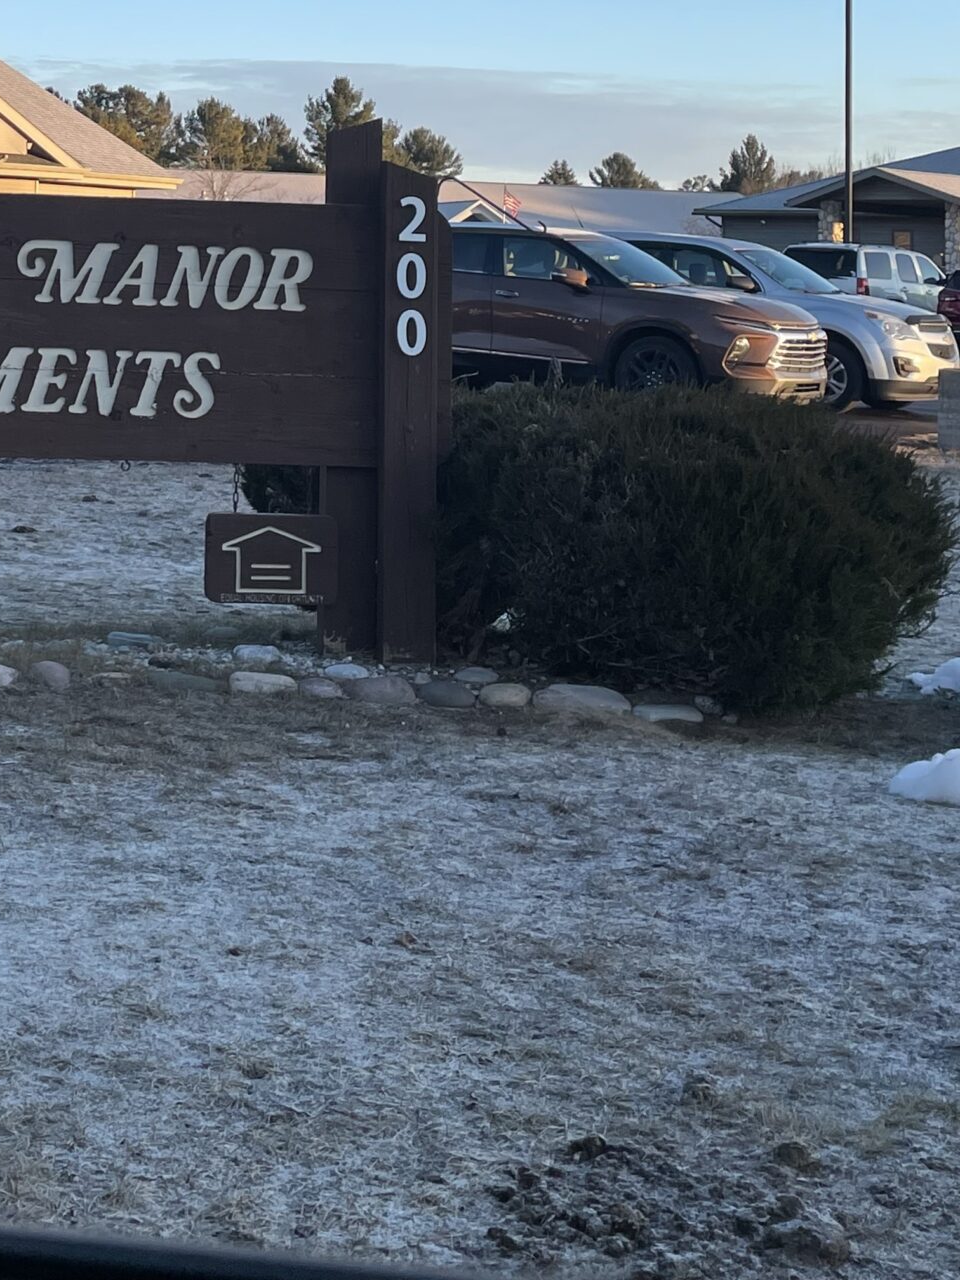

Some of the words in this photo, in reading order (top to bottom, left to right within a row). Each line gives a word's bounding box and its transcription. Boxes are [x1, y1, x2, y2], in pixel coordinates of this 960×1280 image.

[17, 239, 314, 312] MANOR
[396, 196, 427, 356] 200
[245, 594, 276, 603] HOUSING
